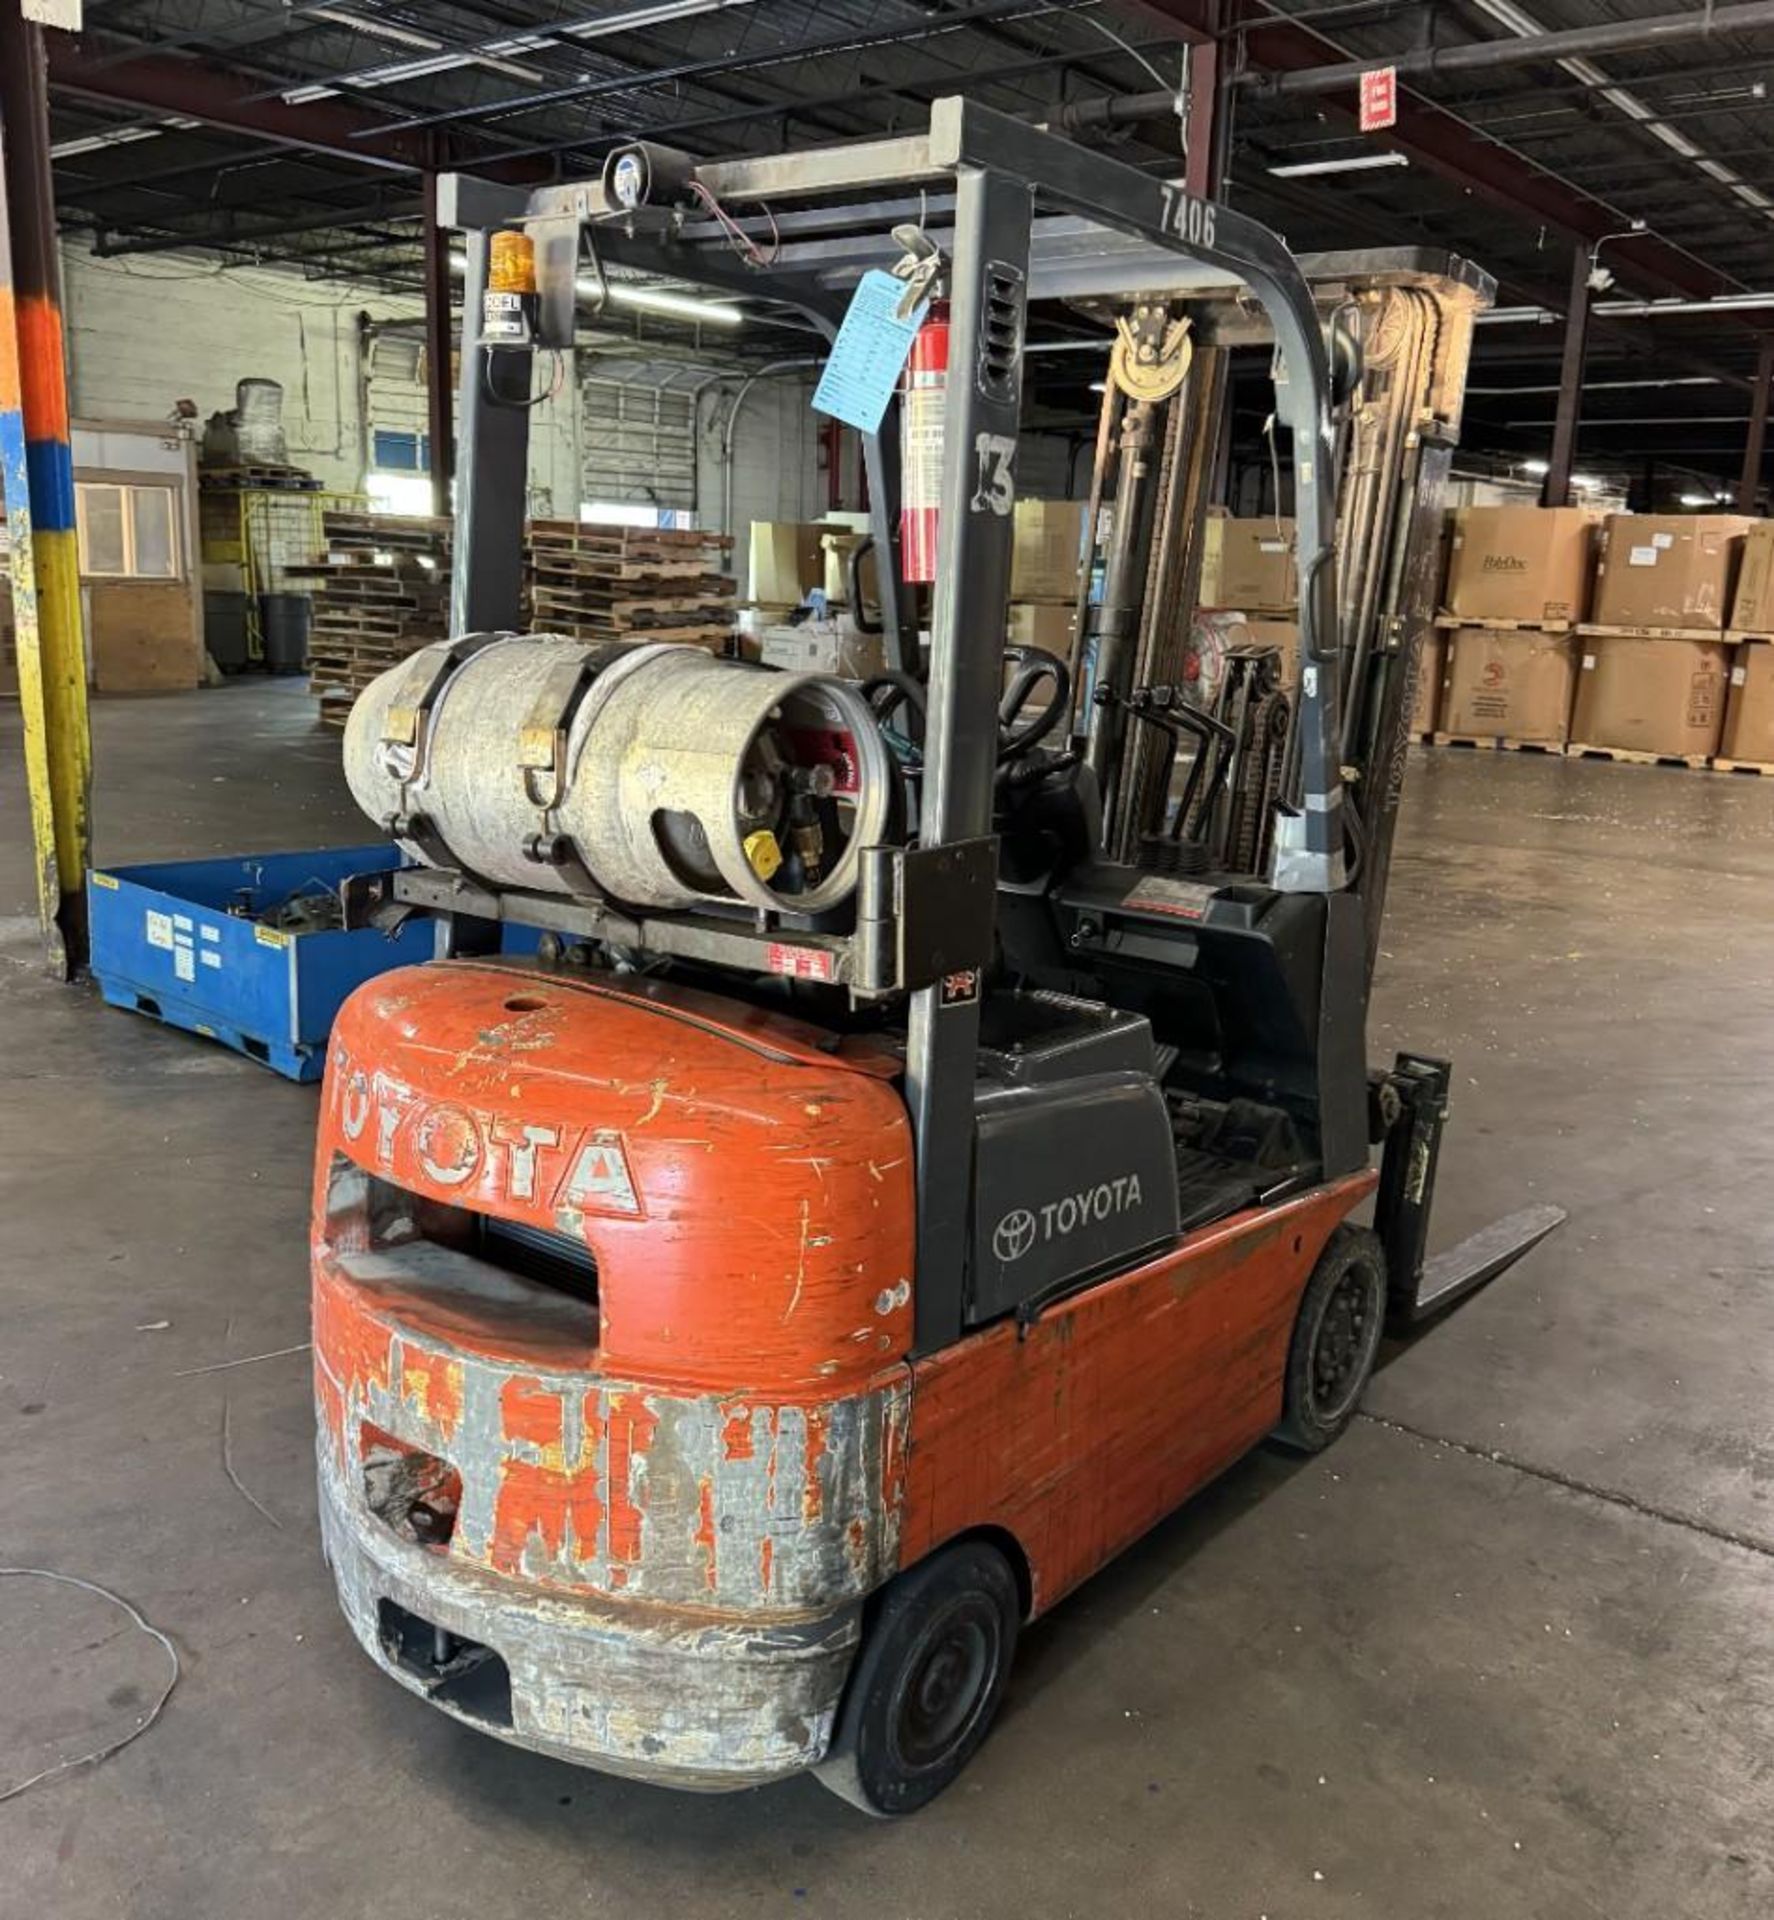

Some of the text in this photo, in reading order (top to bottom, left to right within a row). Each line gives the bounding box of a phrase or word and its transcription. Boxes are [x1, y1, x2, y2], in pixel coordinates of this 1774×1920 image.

[1161, 186, 1216, 249] 7406
[971, 431, 1017, 516] 13
[332, 1048, 648, 1220] TOYOTA
[1040, 1174, 1142, 1241] TOYOTA
